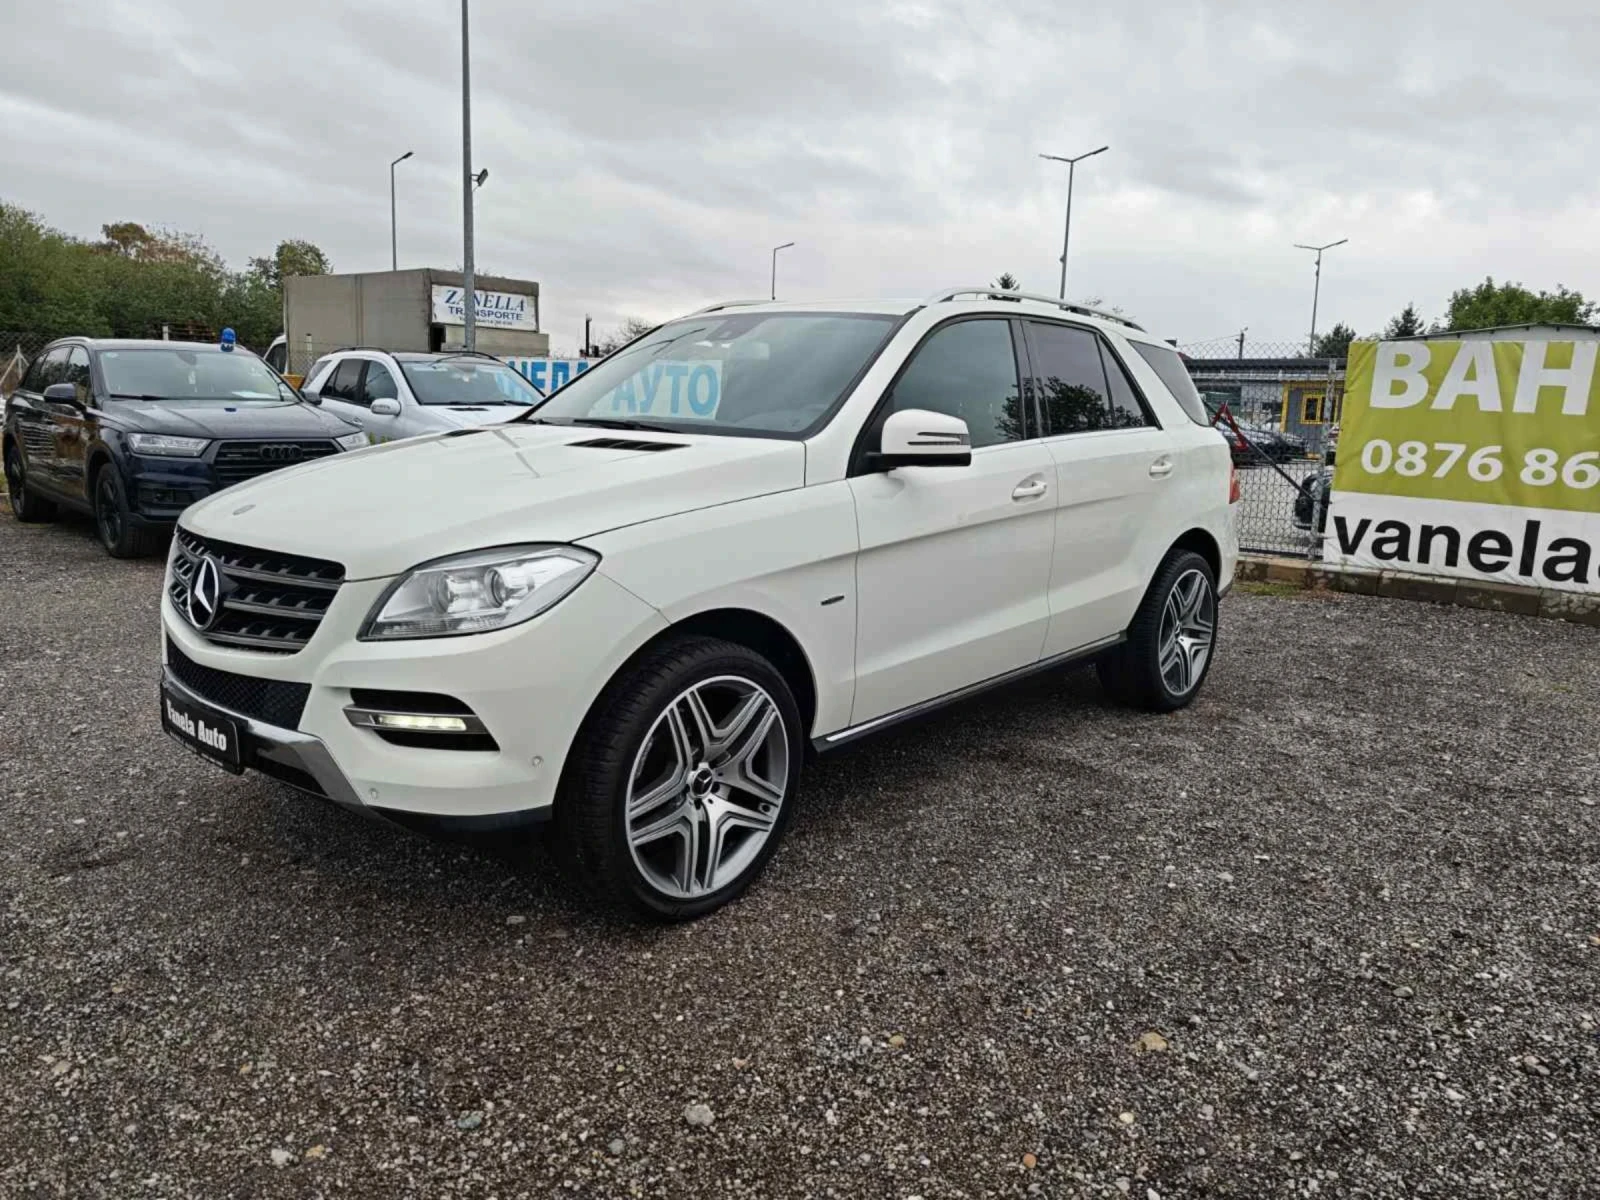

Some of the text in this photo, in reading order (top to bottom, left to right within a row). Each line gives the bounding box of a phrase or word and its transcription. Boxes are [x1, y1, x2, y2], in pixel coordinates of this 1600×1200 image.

[1361, 438, 1600, 490] 0876 86
[1333, 516, 1600, 585] vanela
[198, 719, 227, 752] Auto
